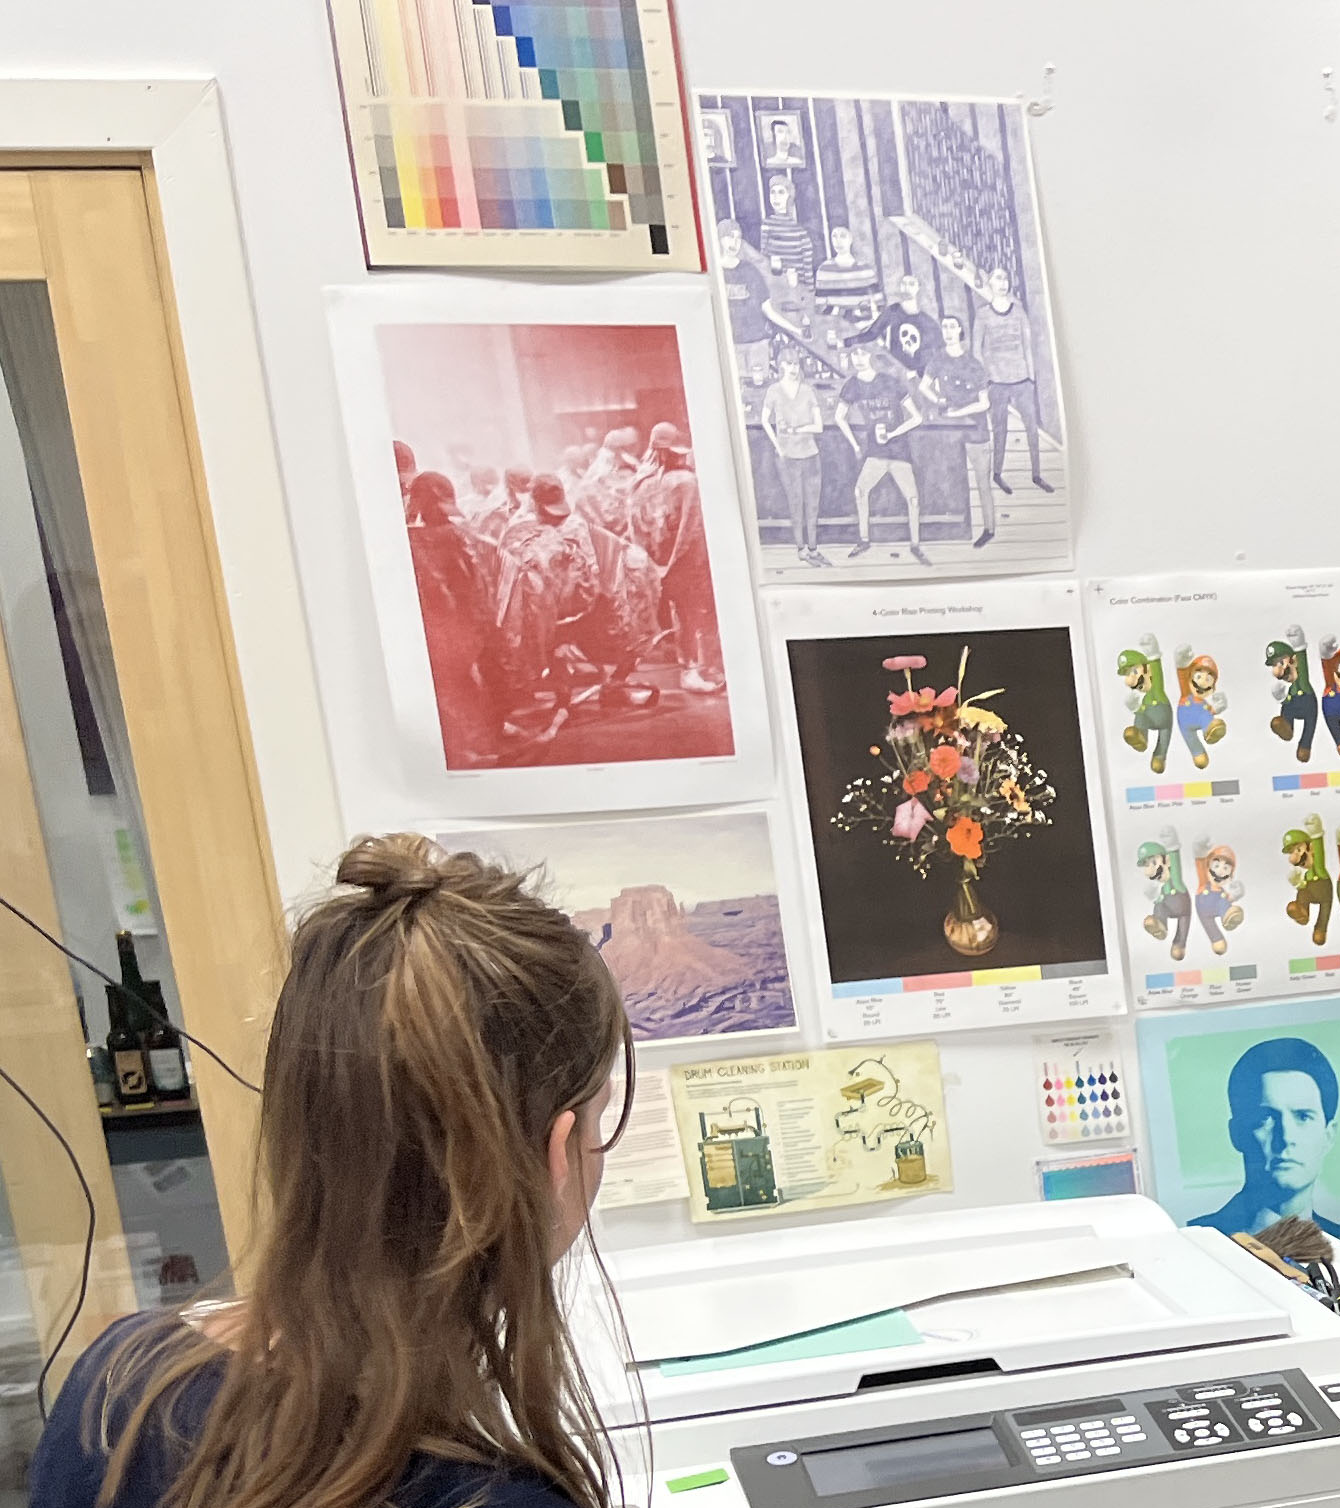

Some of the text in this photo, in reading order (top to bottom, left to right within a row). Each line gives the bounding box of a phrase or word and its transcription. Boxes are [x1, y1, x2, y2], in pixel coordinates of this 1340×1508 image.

[684, 1058, 810, 1081] DRUM CLEANING STATION
